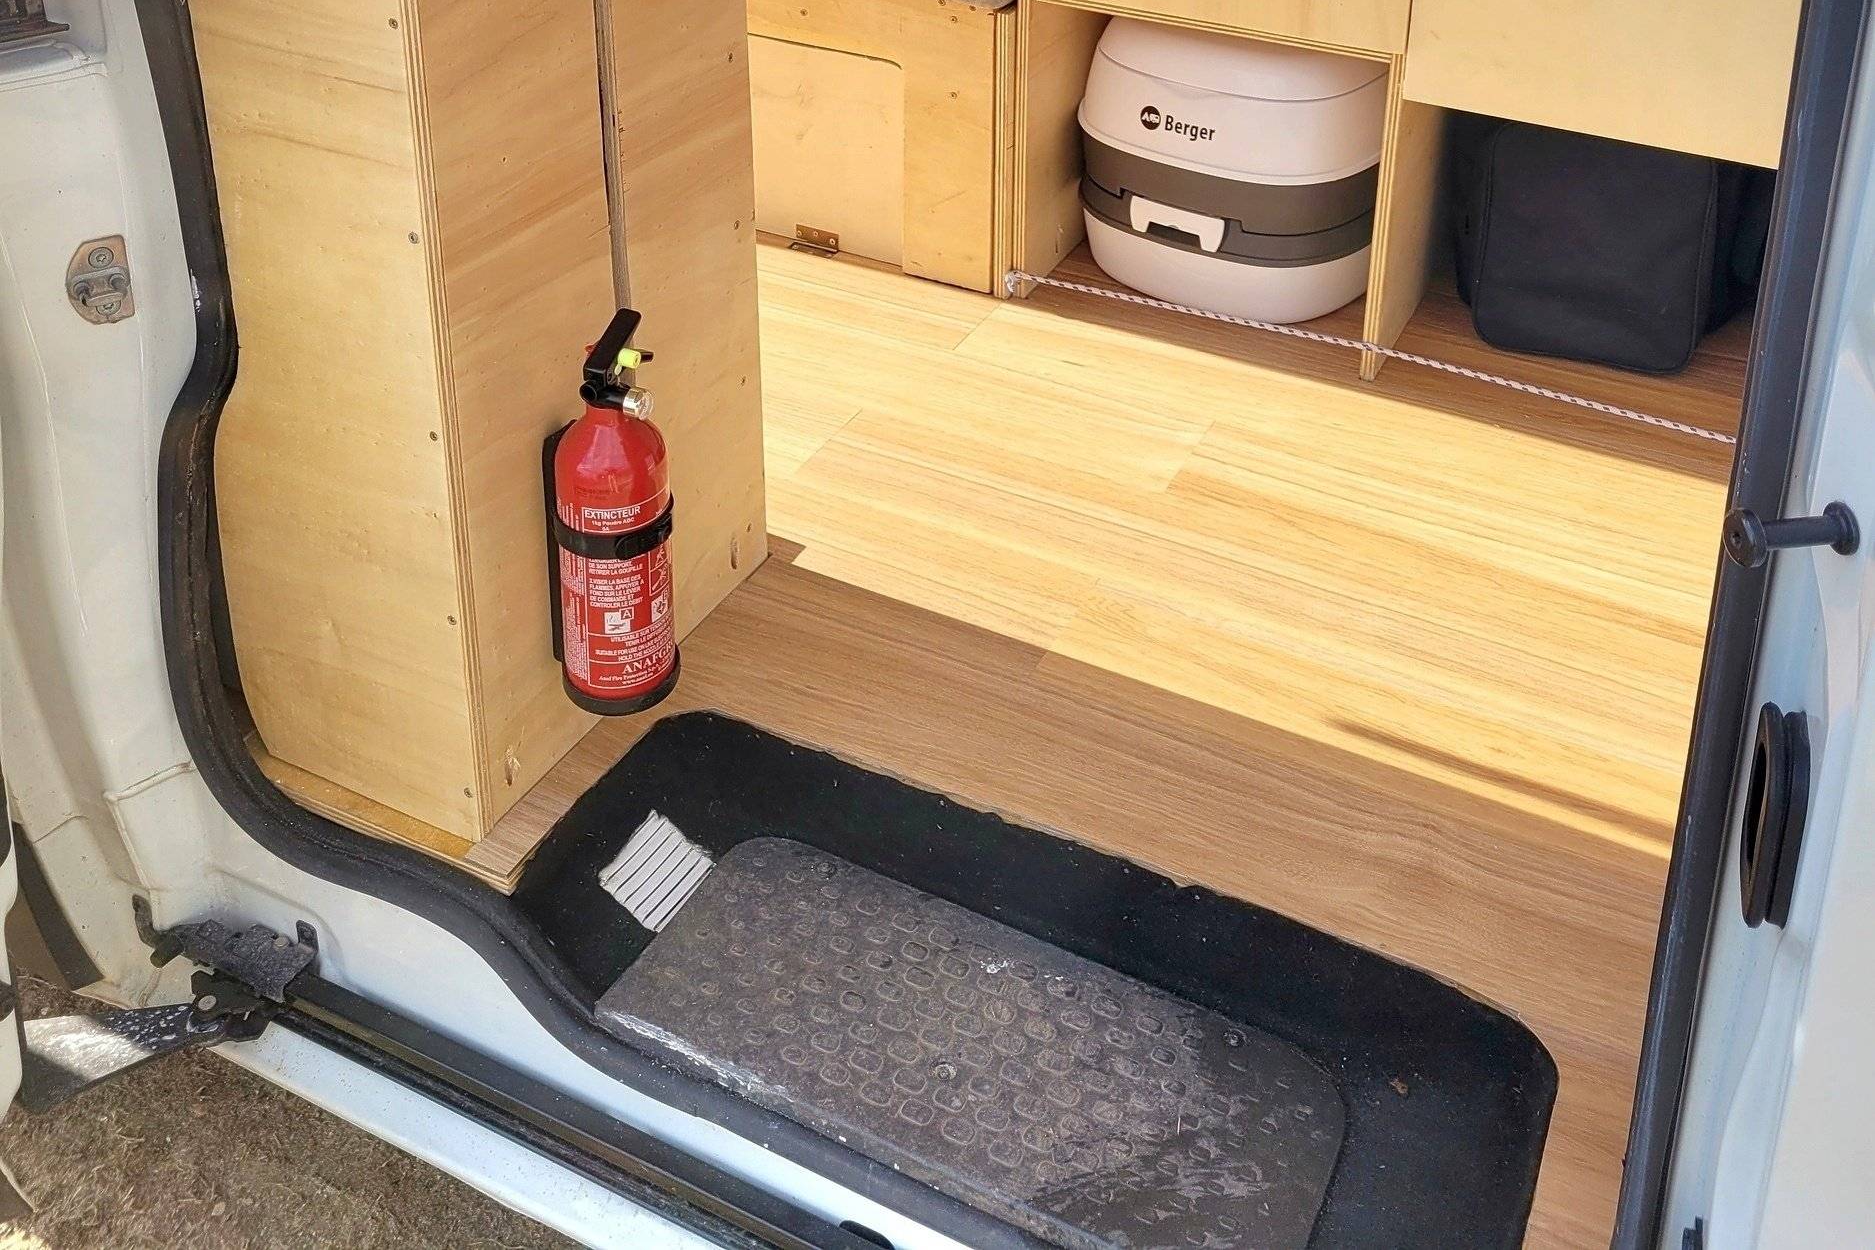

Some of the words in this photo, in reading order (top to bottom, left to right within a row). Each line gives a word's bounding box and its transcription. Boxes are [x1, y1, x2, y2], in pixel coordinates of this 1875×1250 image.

[1164, 114, 1216, 142] Berger
[584, 506, 641, 520] EXTINCTEUR
[589, 568, 611, 576] RETIRER
[619, 563, 643, 574] GOUPILLE
[616, 576, 631, 584] BASE
[631, 573, 642, 582] DES
[615, 580, 640, 591] APPUYER
[615, 588, 622, 596] LE
[623, 585, 641, 595] LEVIER
[597, 595, 627, 603] COMMANDE
[621, 599, 629, 607] LE
[623, 610, 632, 619] A
[610, 632, 640, 642] UTILISABLE
[640, 627, 650, 637] SUR
[618, 648, 629, 656] FOR
[628, 646, 638, 654] USE
[618, 653, 633, 661] HOLD
[633, 650, 643, 659] THE
